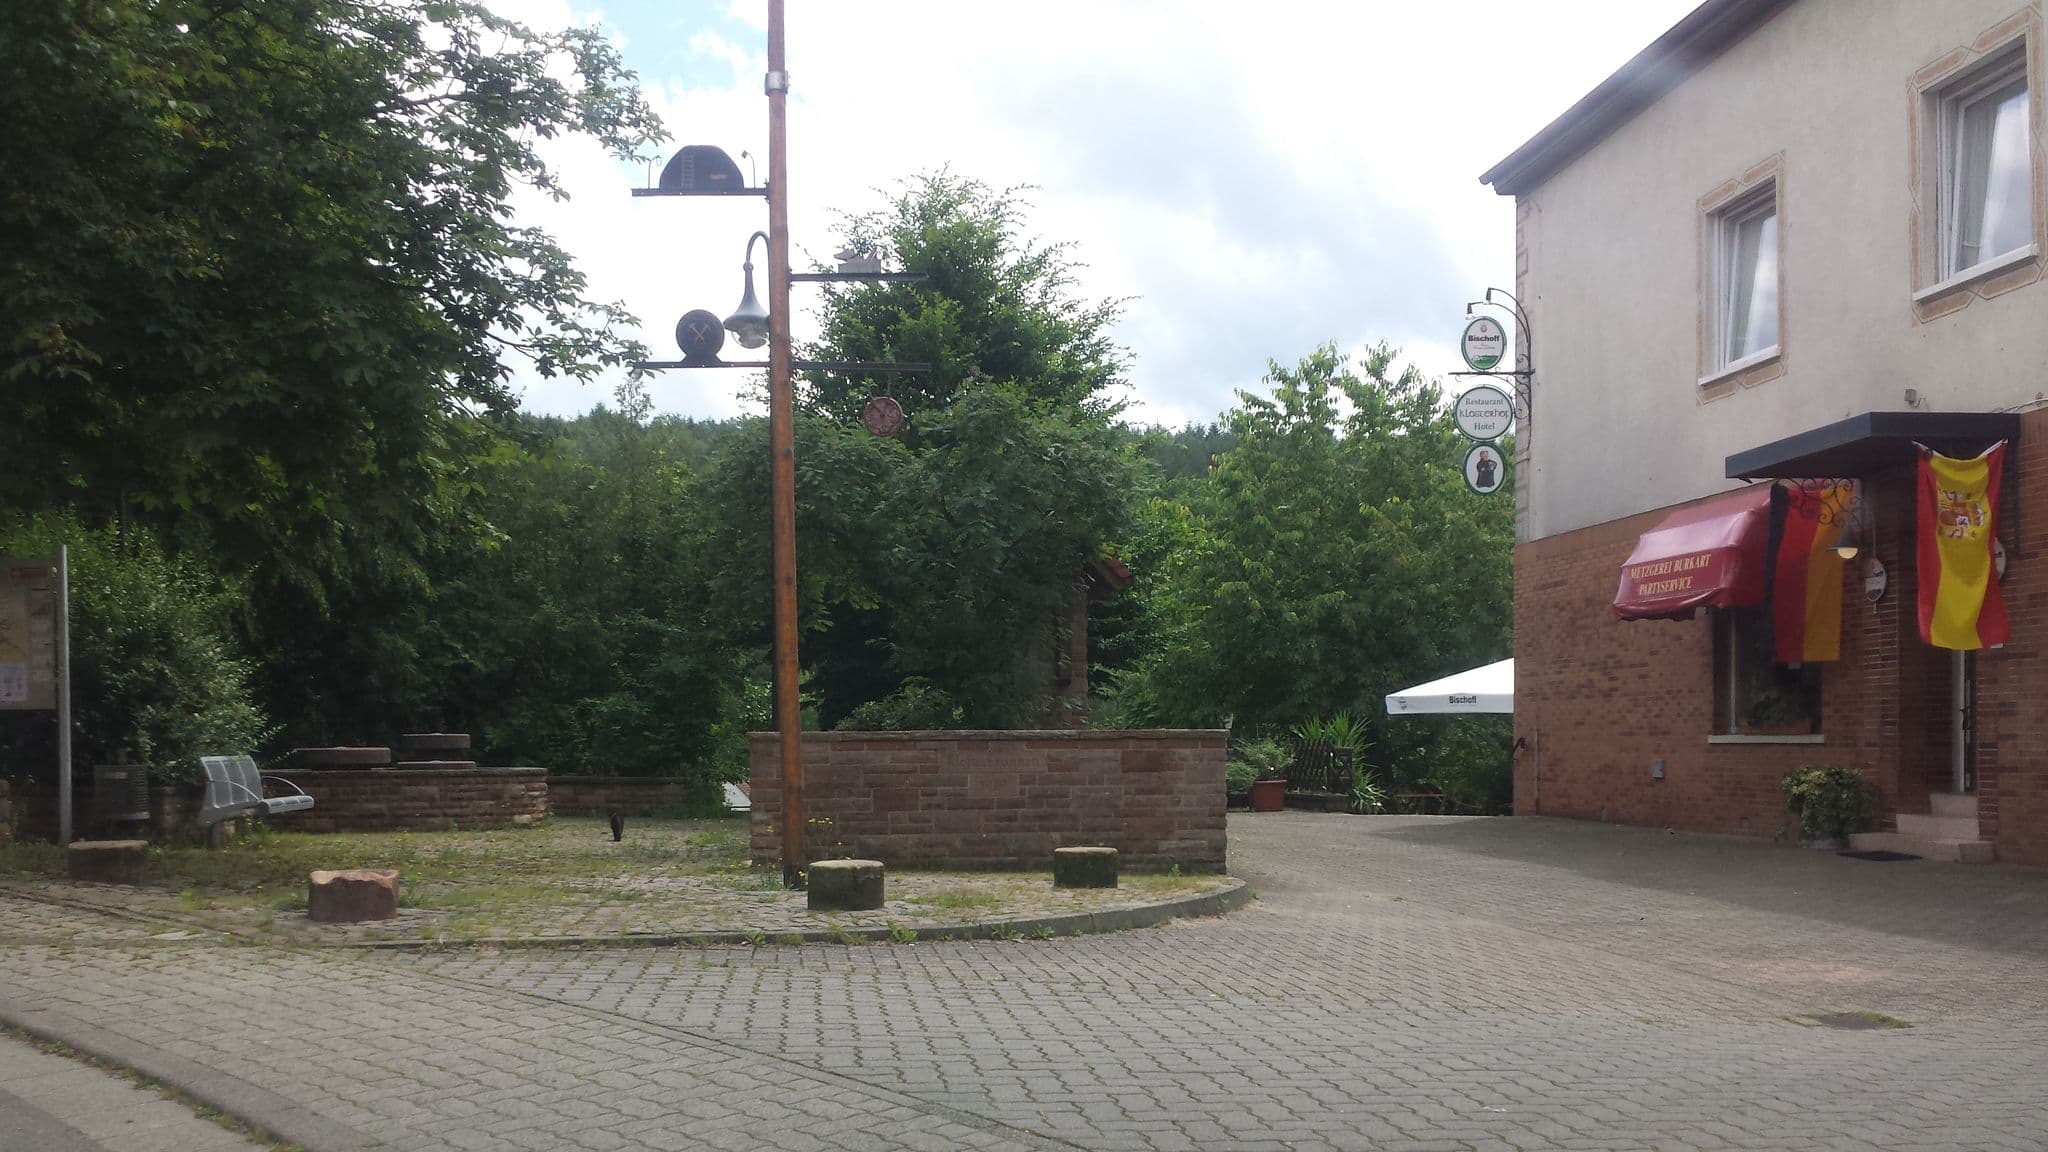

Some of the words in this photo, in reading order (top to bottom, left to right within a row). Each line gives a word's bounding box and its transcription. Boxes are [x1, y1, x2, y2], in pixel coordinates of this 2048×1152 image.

[1465, 397, 1504, 406] Restaurant
[1474, 422, 1496, 431] Hotel
[1631, 562, 1673, 579] METZGEREI
[1674, 554, 1712, 572] BURKART
[1639, 576, 1694, 595] PARTYSERVICE
[1448, 695, 1477, 704] Bischoff
